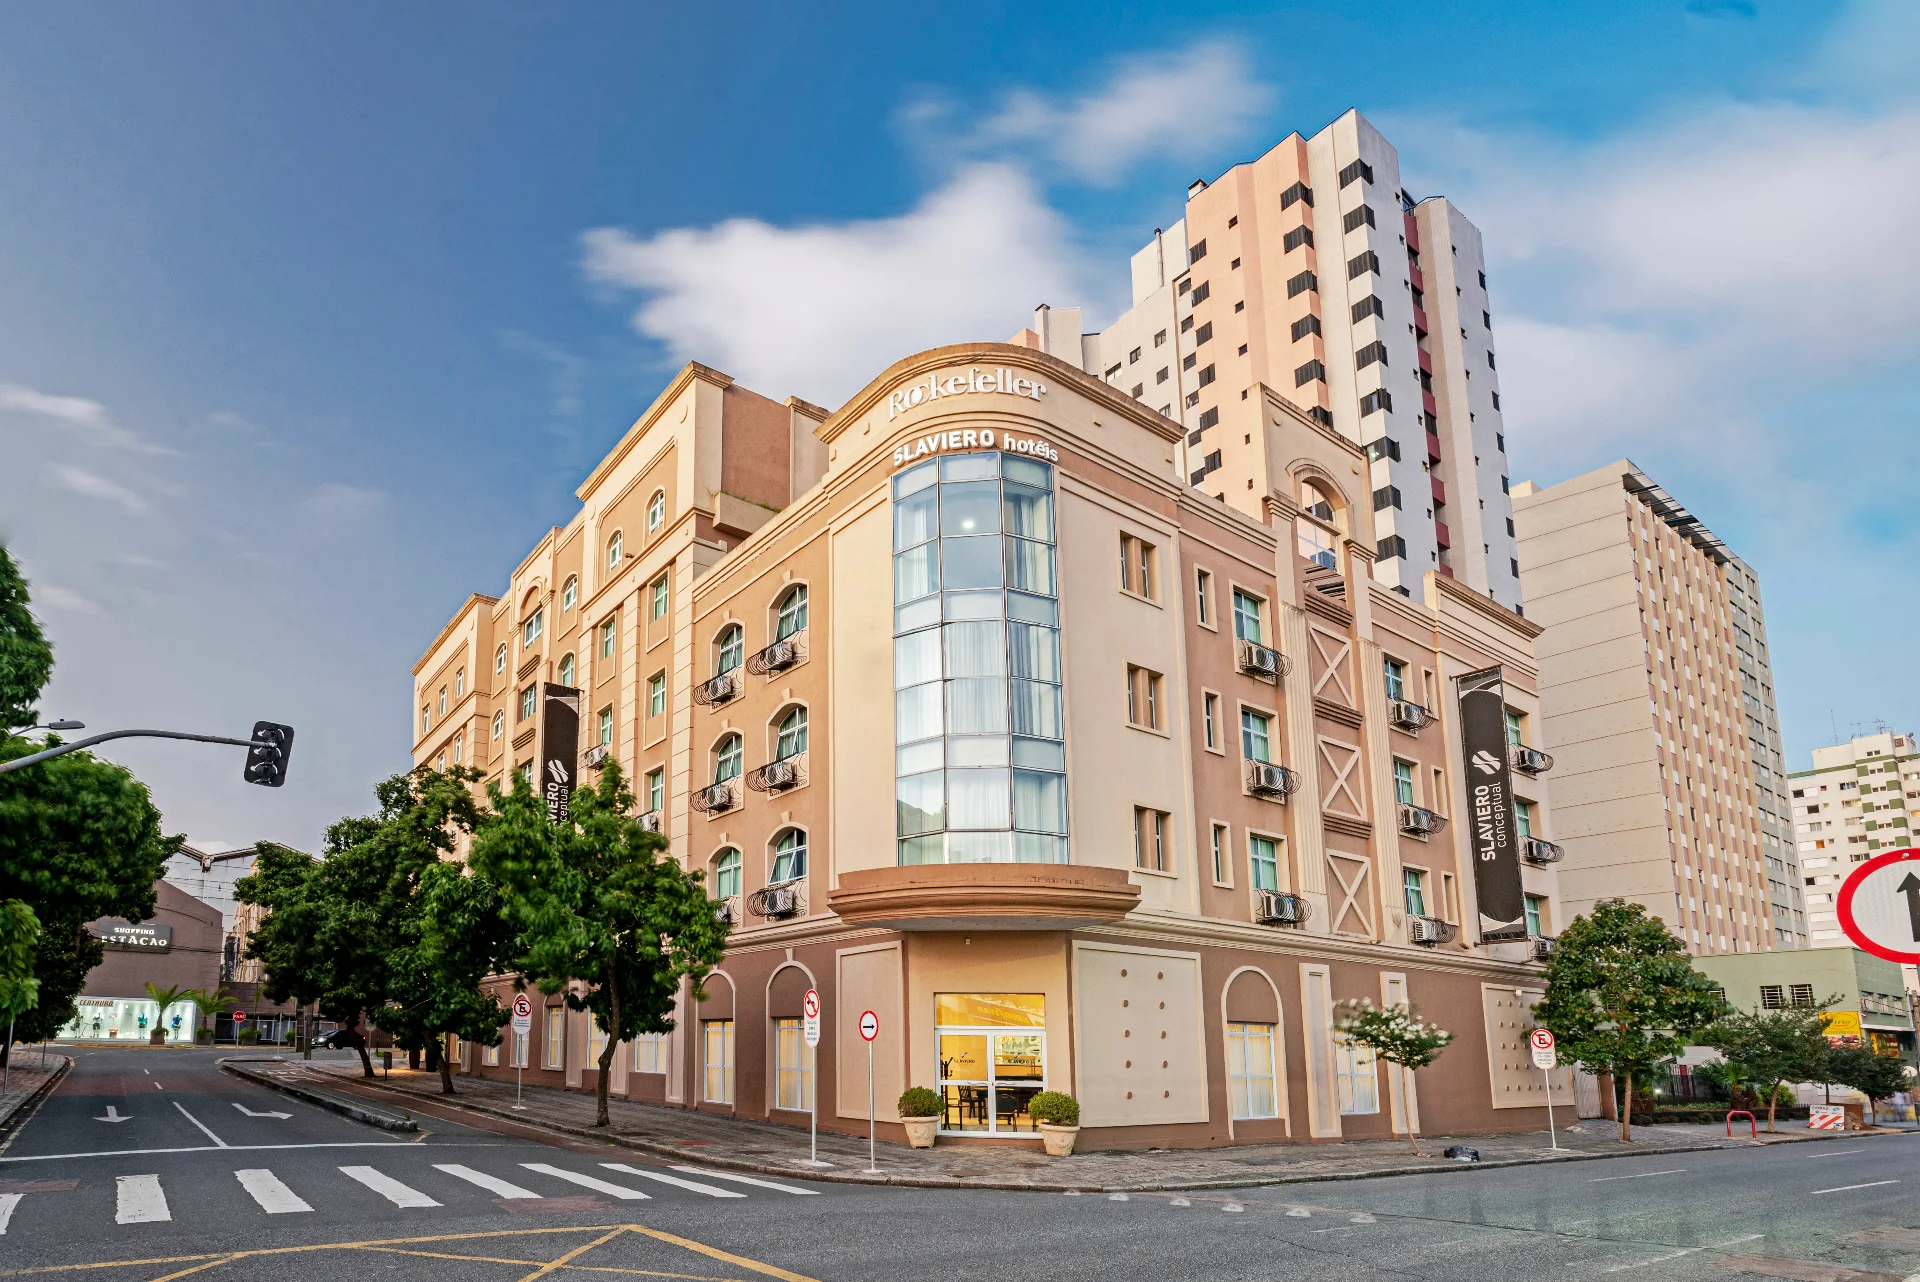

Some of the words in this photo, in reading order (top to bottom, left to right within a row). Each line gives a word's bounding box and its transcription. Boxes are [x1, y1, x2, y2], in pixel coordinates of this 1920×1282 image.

[893, 429, 995, 466] SLAVIERO
[559, 785, 570, 822] ceptual
[1489, 782, 1507, 848] conceptual
[1475, 785, 1496, 861] SLAVIERO
[114, 927, 155, 935] SHOPPING
